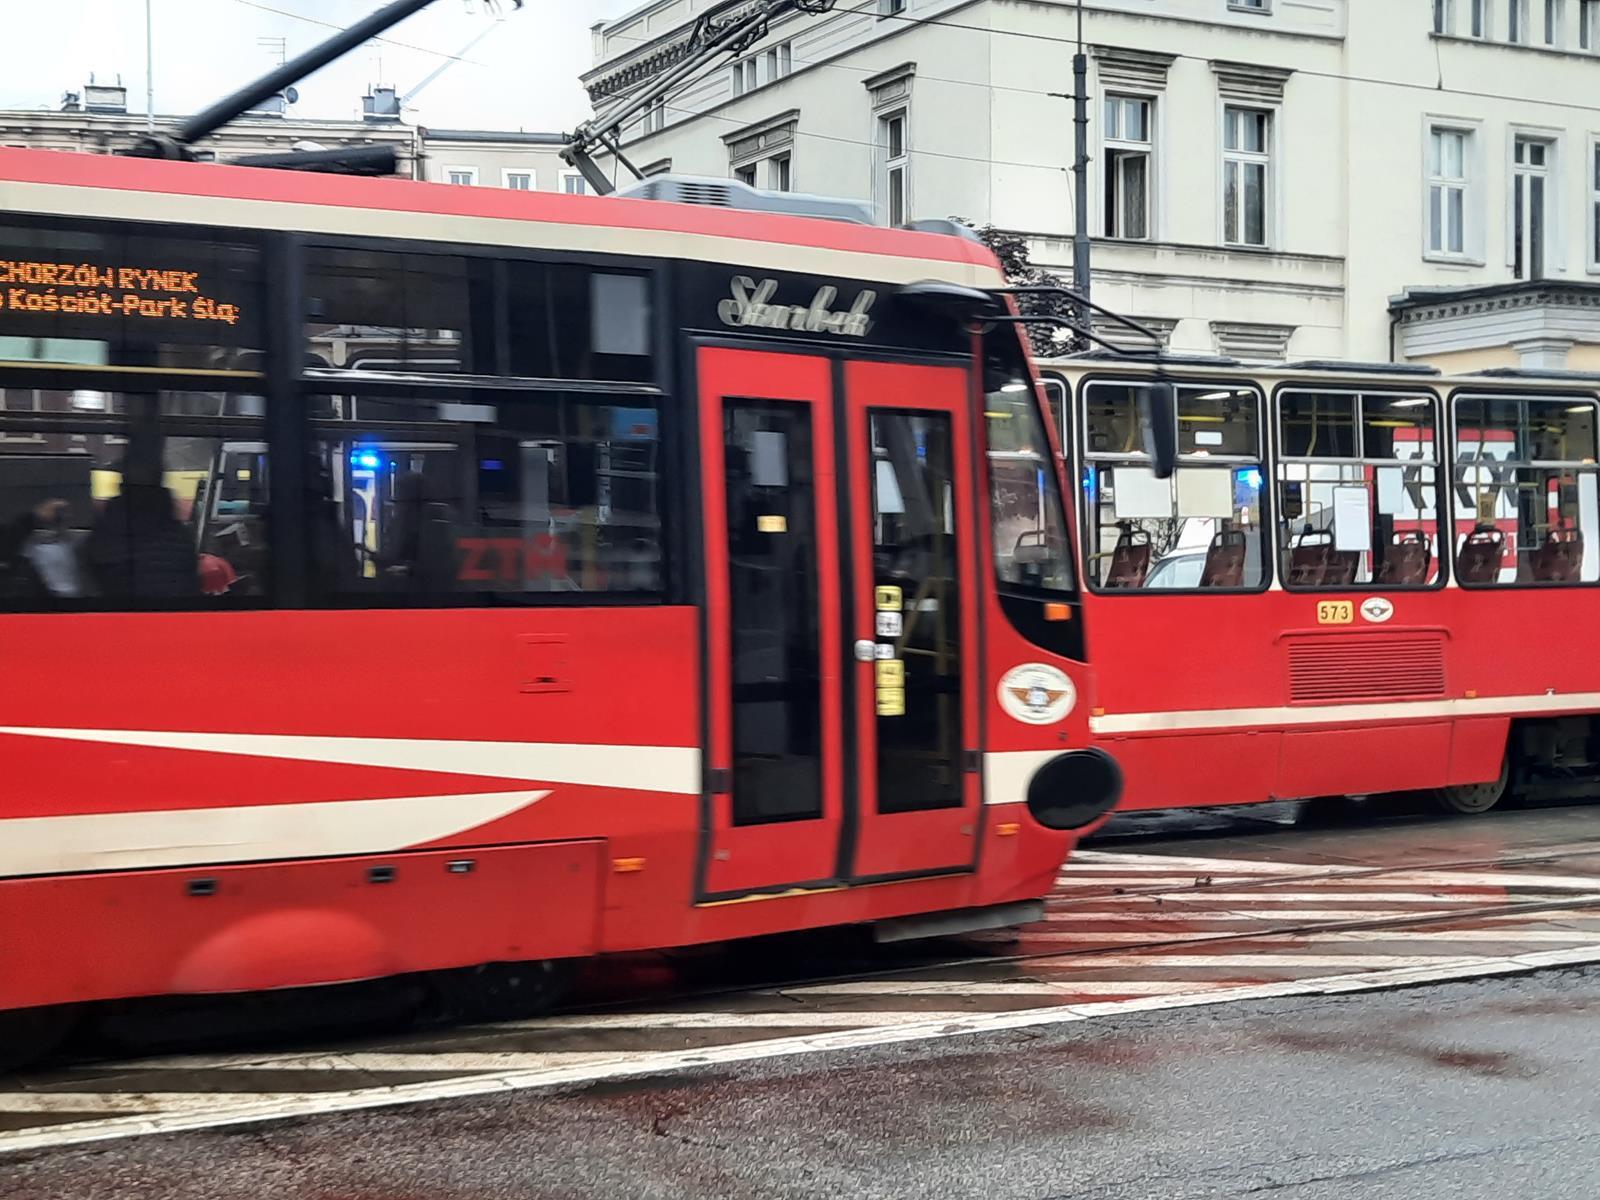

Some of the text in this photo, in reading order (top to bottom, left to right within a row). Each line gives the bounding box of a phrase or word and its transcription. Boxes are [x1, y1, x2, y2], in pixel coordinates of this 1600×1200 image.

[0, 260, 198, 293] CHORZÓW RYNEK
[1320, 605, 1348, 620] 573
